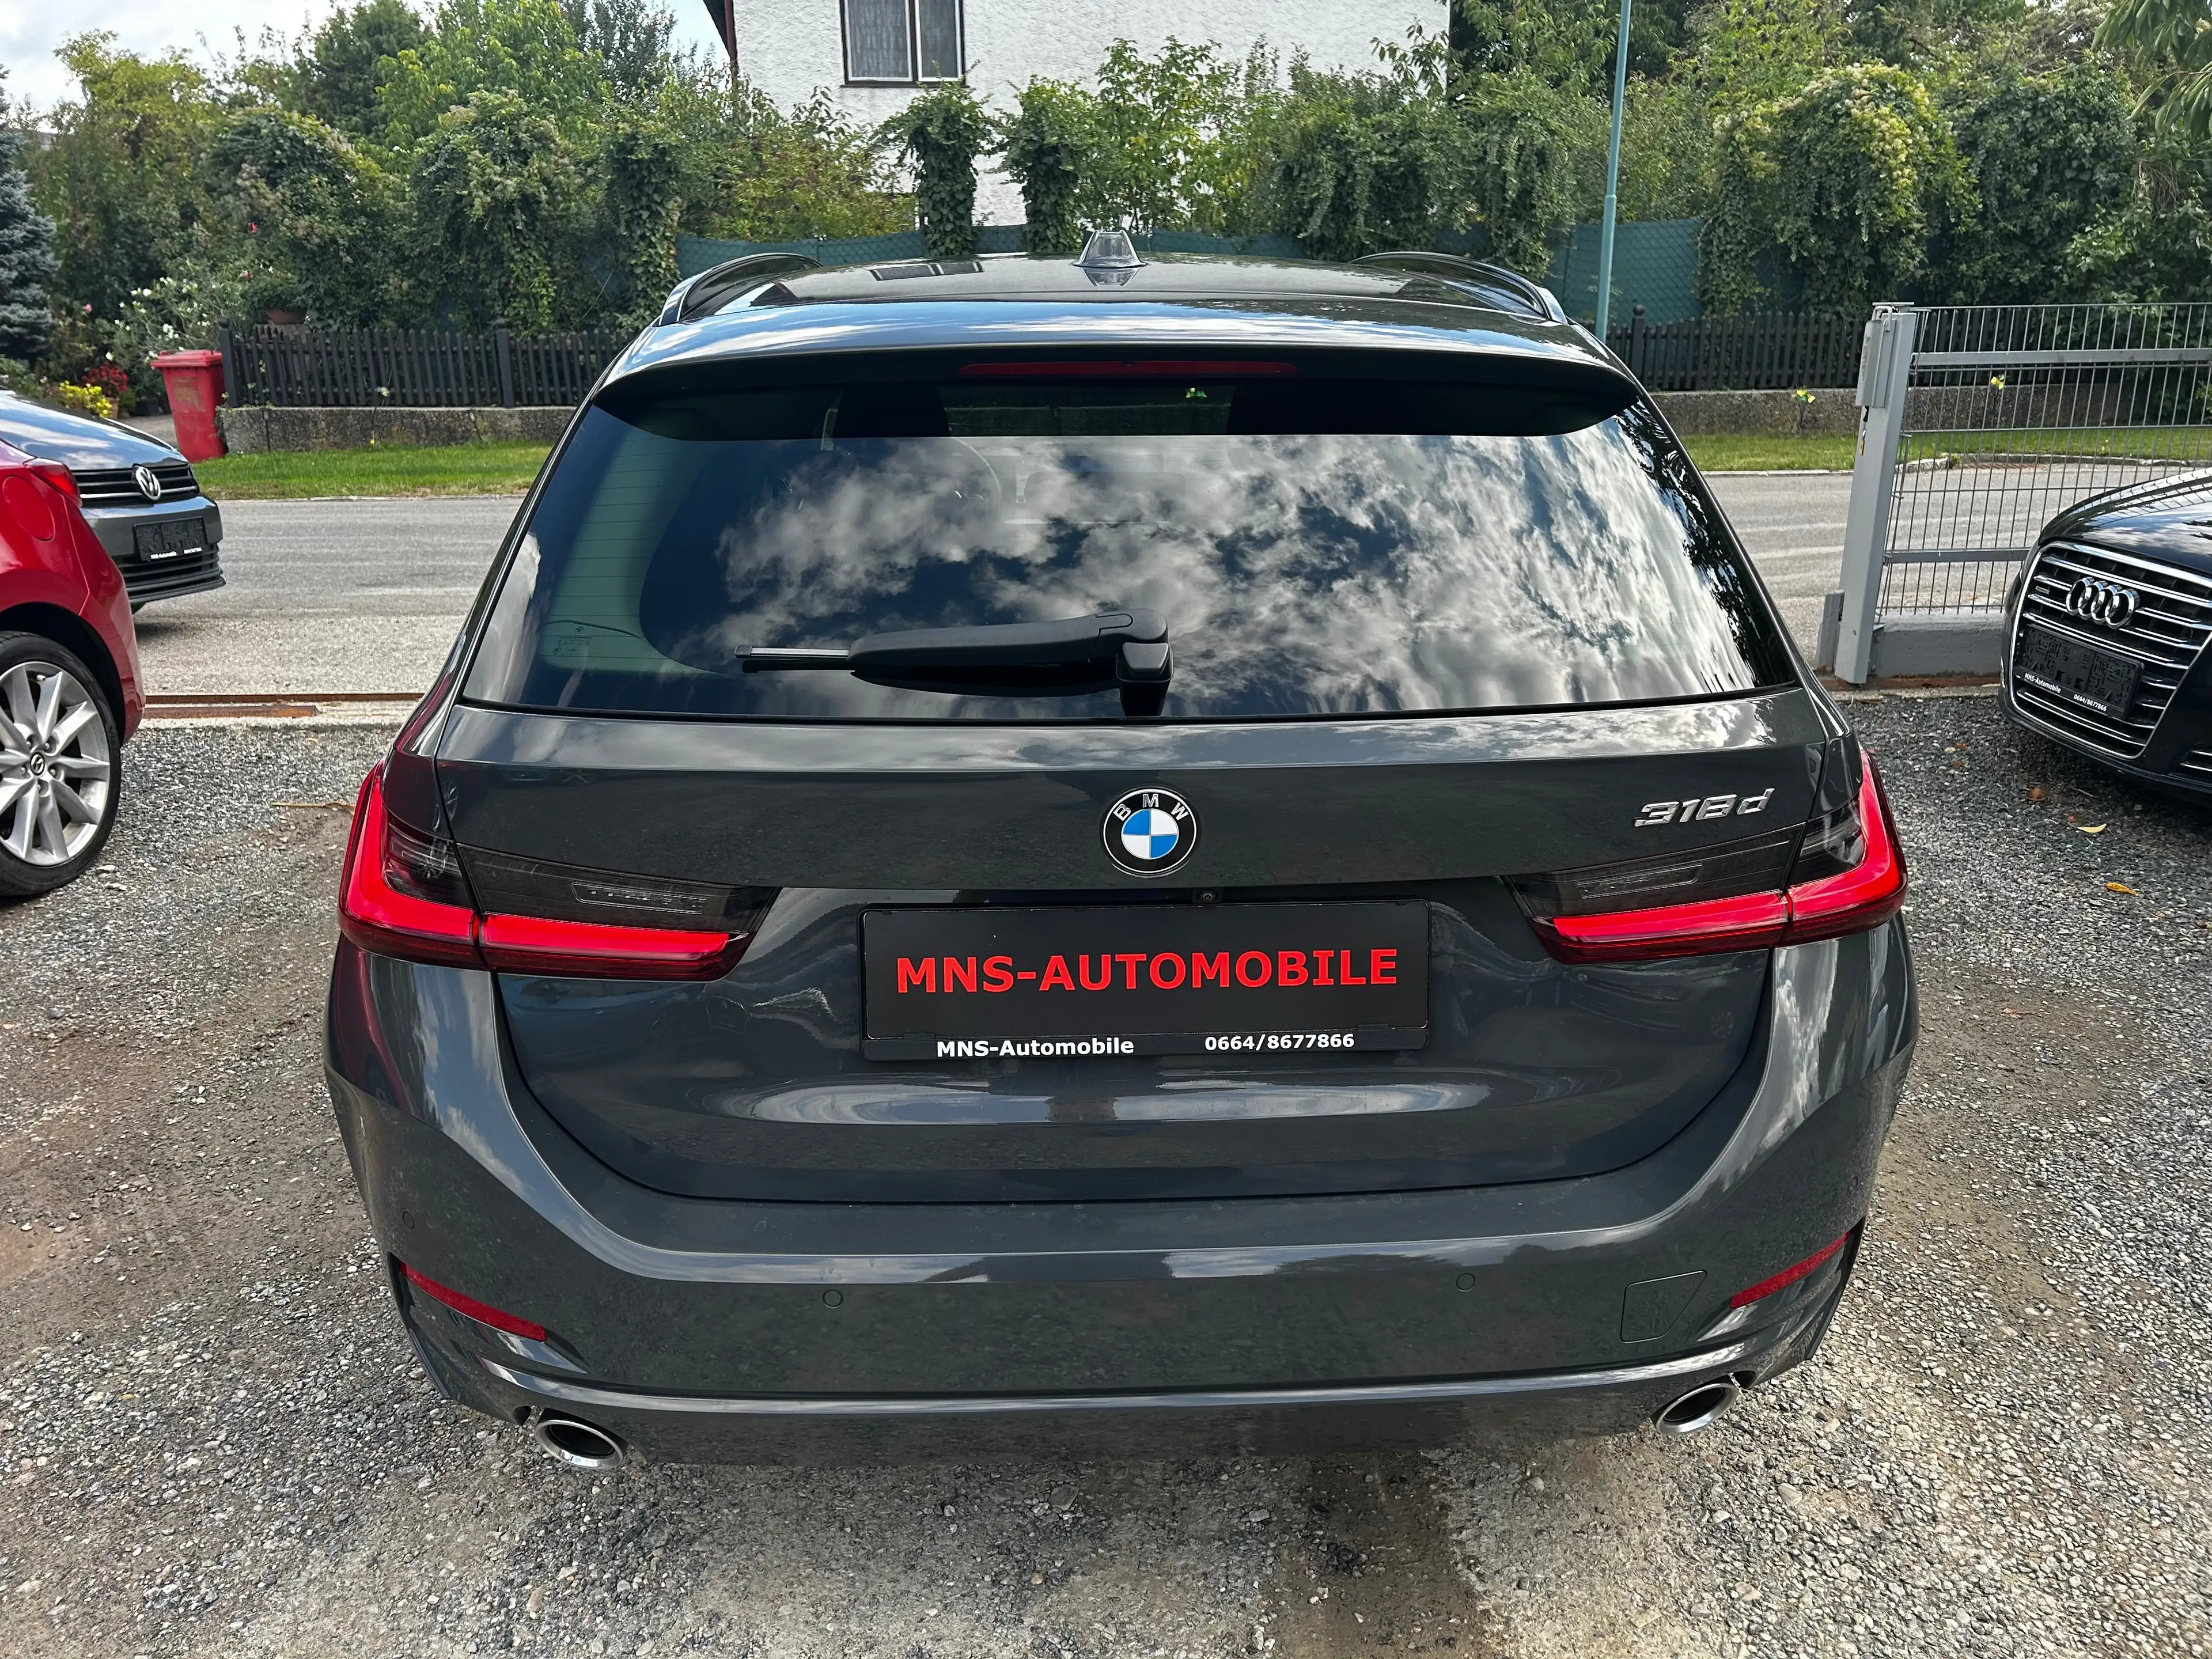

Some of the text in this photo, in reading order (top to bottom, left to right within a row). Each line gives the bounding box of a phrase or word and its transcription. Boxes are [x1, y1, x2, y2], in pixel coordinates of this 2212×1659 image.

[2024, 672, 2061, 694] MNS-Automobile
[1113, 793, 1189, 821] BMW
[1634, 788, 1775, 827] 318d
[896, 948, 1397, 994] MNS-AUTOMOBILE
[937, 1033, 1354, 1058] MNS-Automobile 0664/8677866
